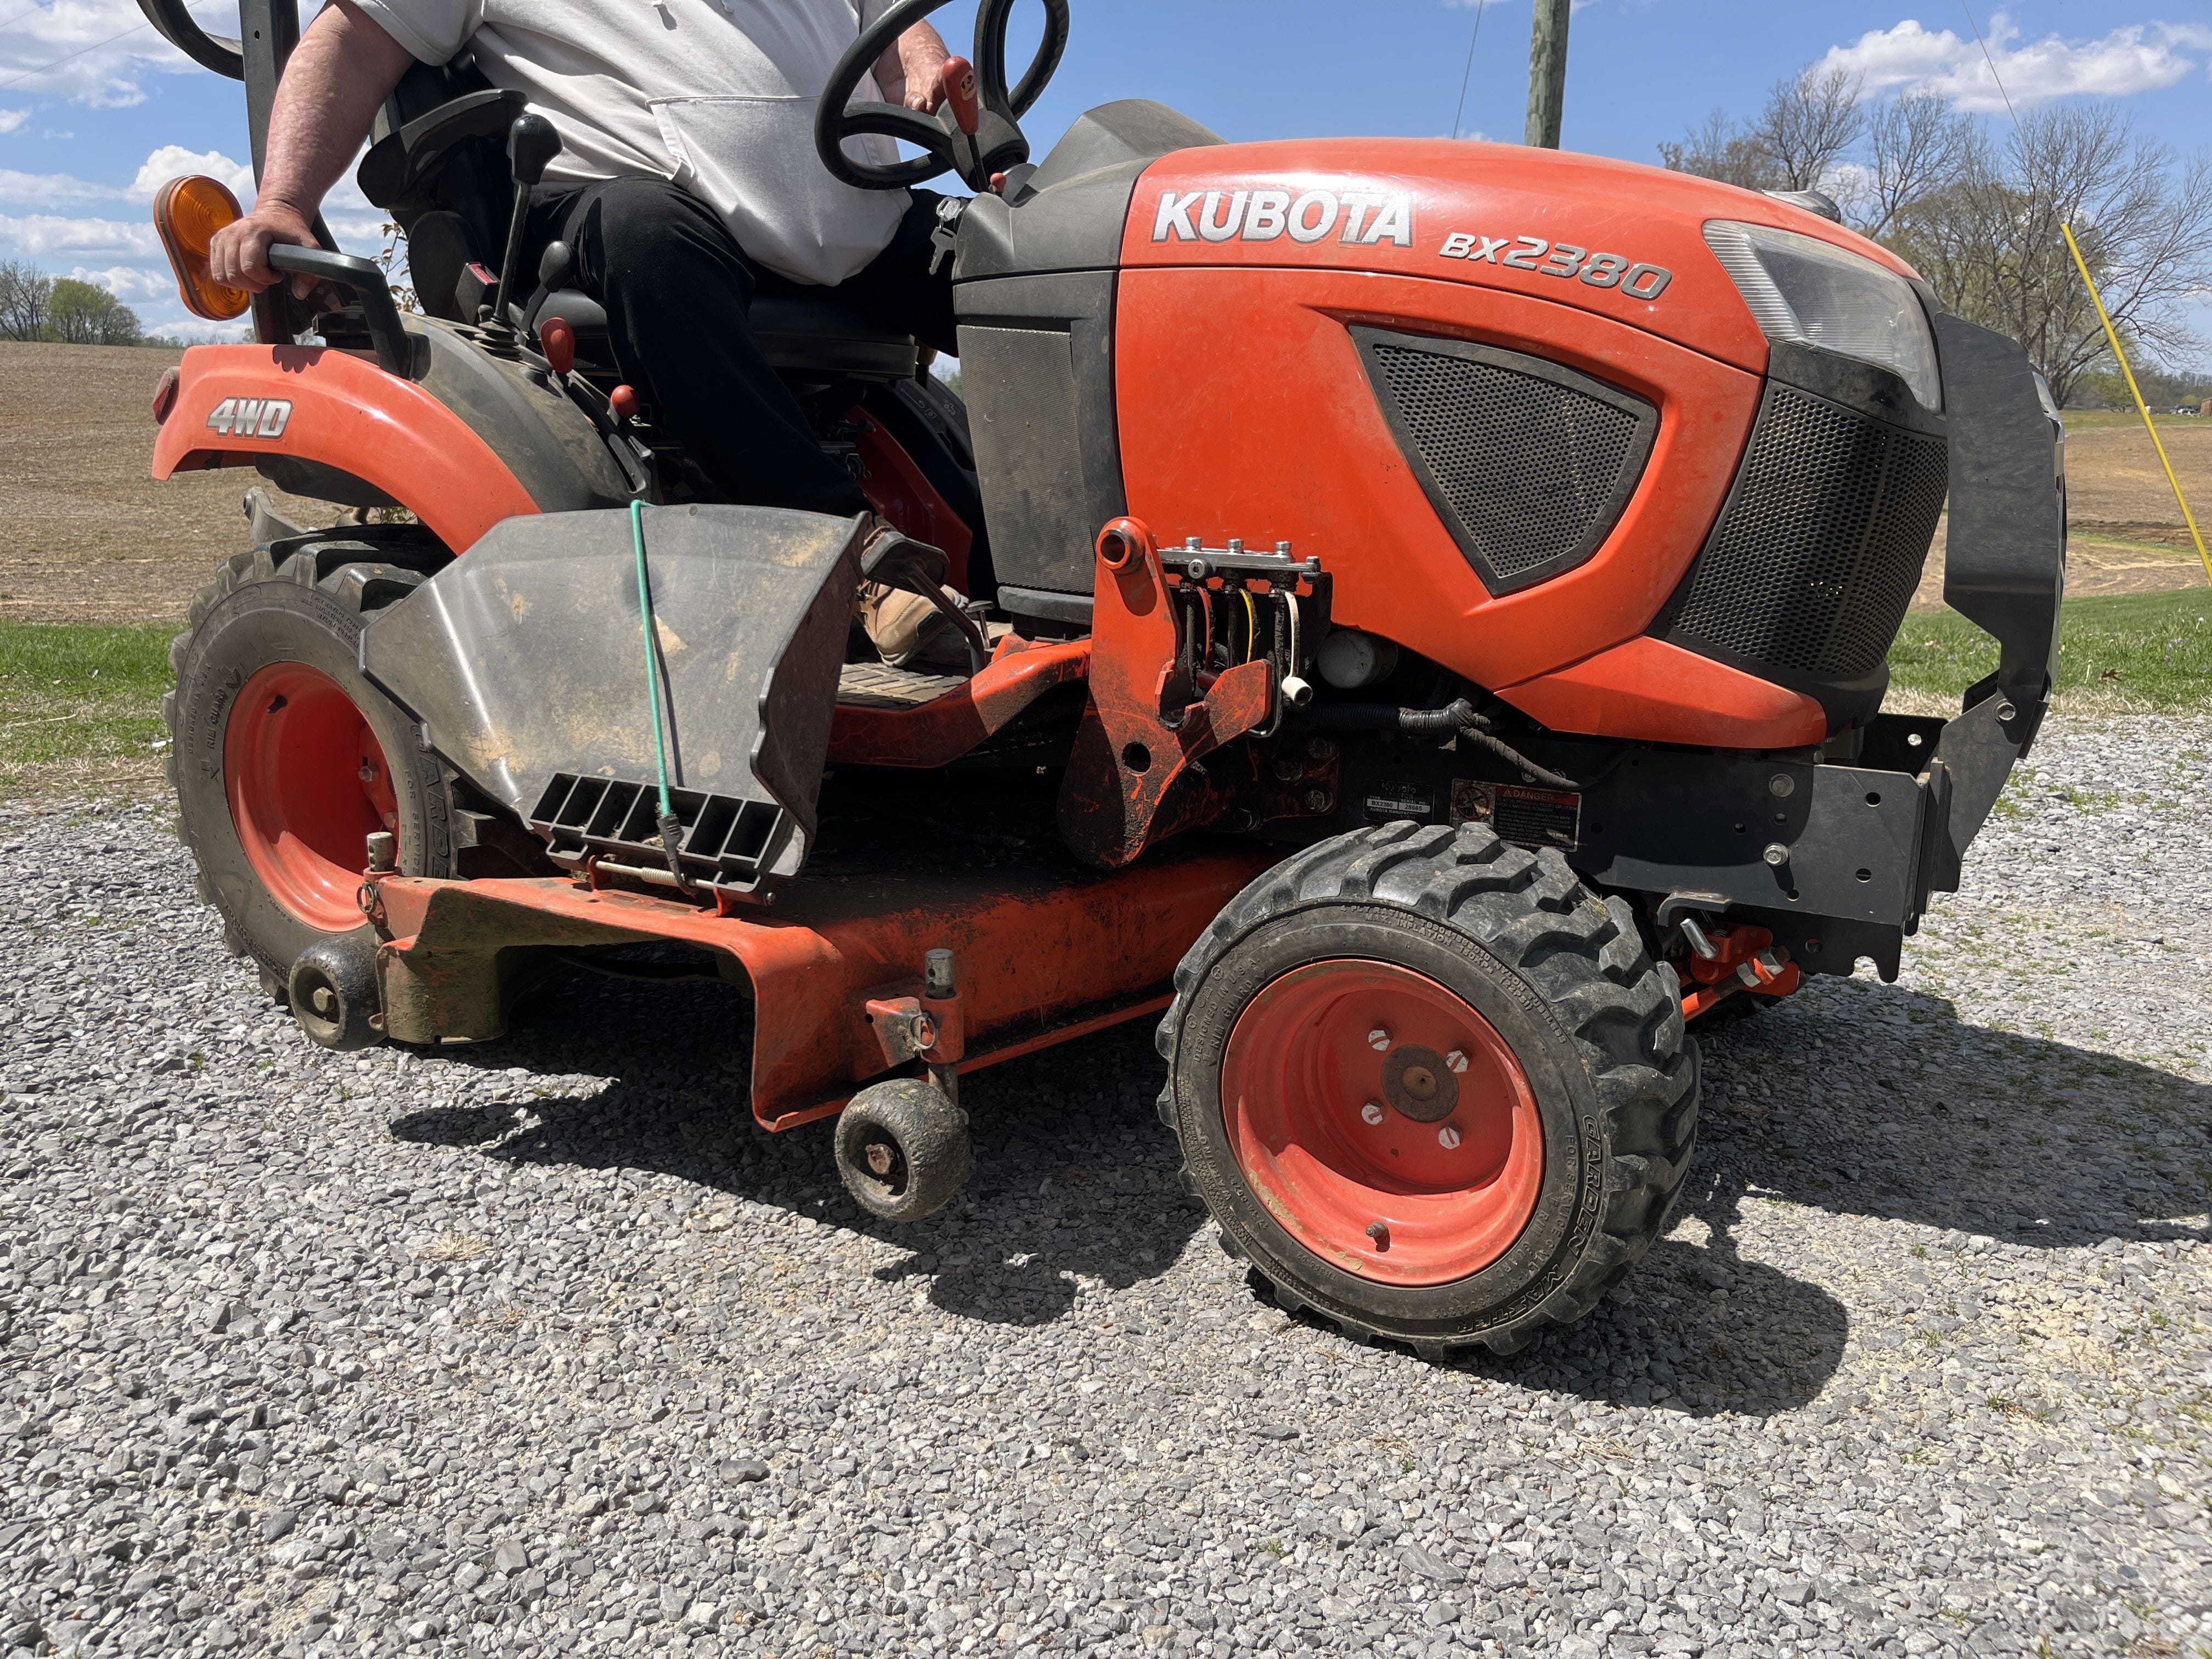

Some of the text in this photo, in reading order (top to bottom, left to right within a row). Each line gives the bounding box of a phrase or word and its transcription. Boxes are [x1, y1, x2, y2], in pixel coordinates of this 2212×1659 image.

[1151, 191, 1413, 247] KUBOTA
[1438, 232, 1673, 300] BX2380
[207, 397, 292, 438] 4WD
[206, 726, 217, 750] RIM
[404, 769, 421, 875] FOR SERVICE
[409, 724, 448, 878] GARDE
[1513, 790, 1554, 802] DANGER
[1365, 913, 1392, 925] MAX.
[1396, 918, 1453, 947] INFLATION
[1374, 906, 1415, 921] RATING
[1493, 961, 1527, 992] NYLON
[1528, 992, 1567, 1045] TUBELESS
[1193, 1001, 1218, 1063] DESIGNED
[1217, 985, 1229, 999] IN
[1210, 979, 1254, 1049] RIM GUARD
[1565, 1135, 1577, 1167] FOR
[1457, 1114, 1602, 1335] GARDEN MASTER
[1532, 1209, 1550, 1238] RIM
[1550, 1171, 1577, 1239] SERVICE
[1528, 1238, 1555, 1272] CALL
